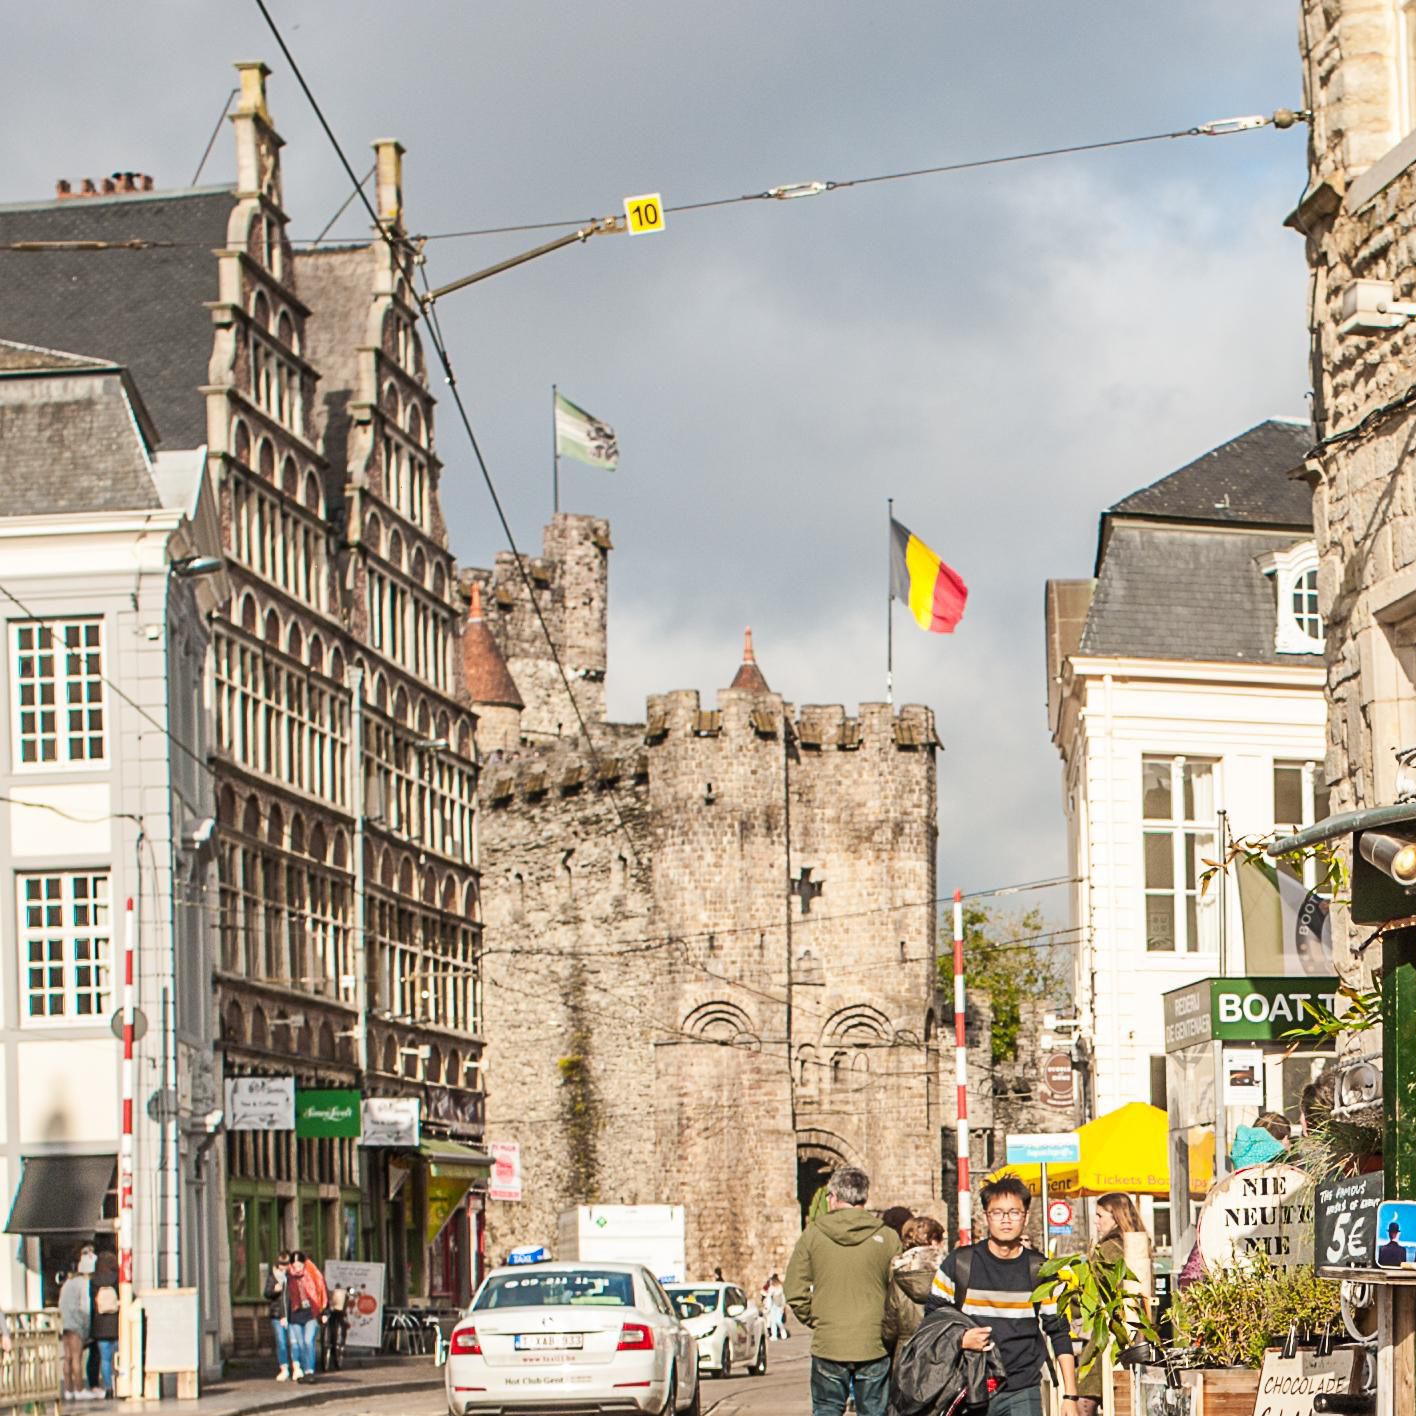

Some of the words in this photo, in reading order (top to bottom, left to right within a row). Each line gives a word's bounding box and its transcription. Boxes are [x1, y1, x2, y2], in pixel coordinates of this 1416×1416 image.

[633, 204, 657, 226] 10
[1218, 993, 1311, 1022] BOAT
[1046, 1178, 1072, 1191] ent
[1095, 1174, 1142, 1185] Tickets
[1242, 1177, 1286, 1197] NIE
[1245, 1236, 1290, 1256] NIE
[1327, 1212, 1367, 1264] 5€
[1264, 1376, 1346, 1395] CHOCOLADE
